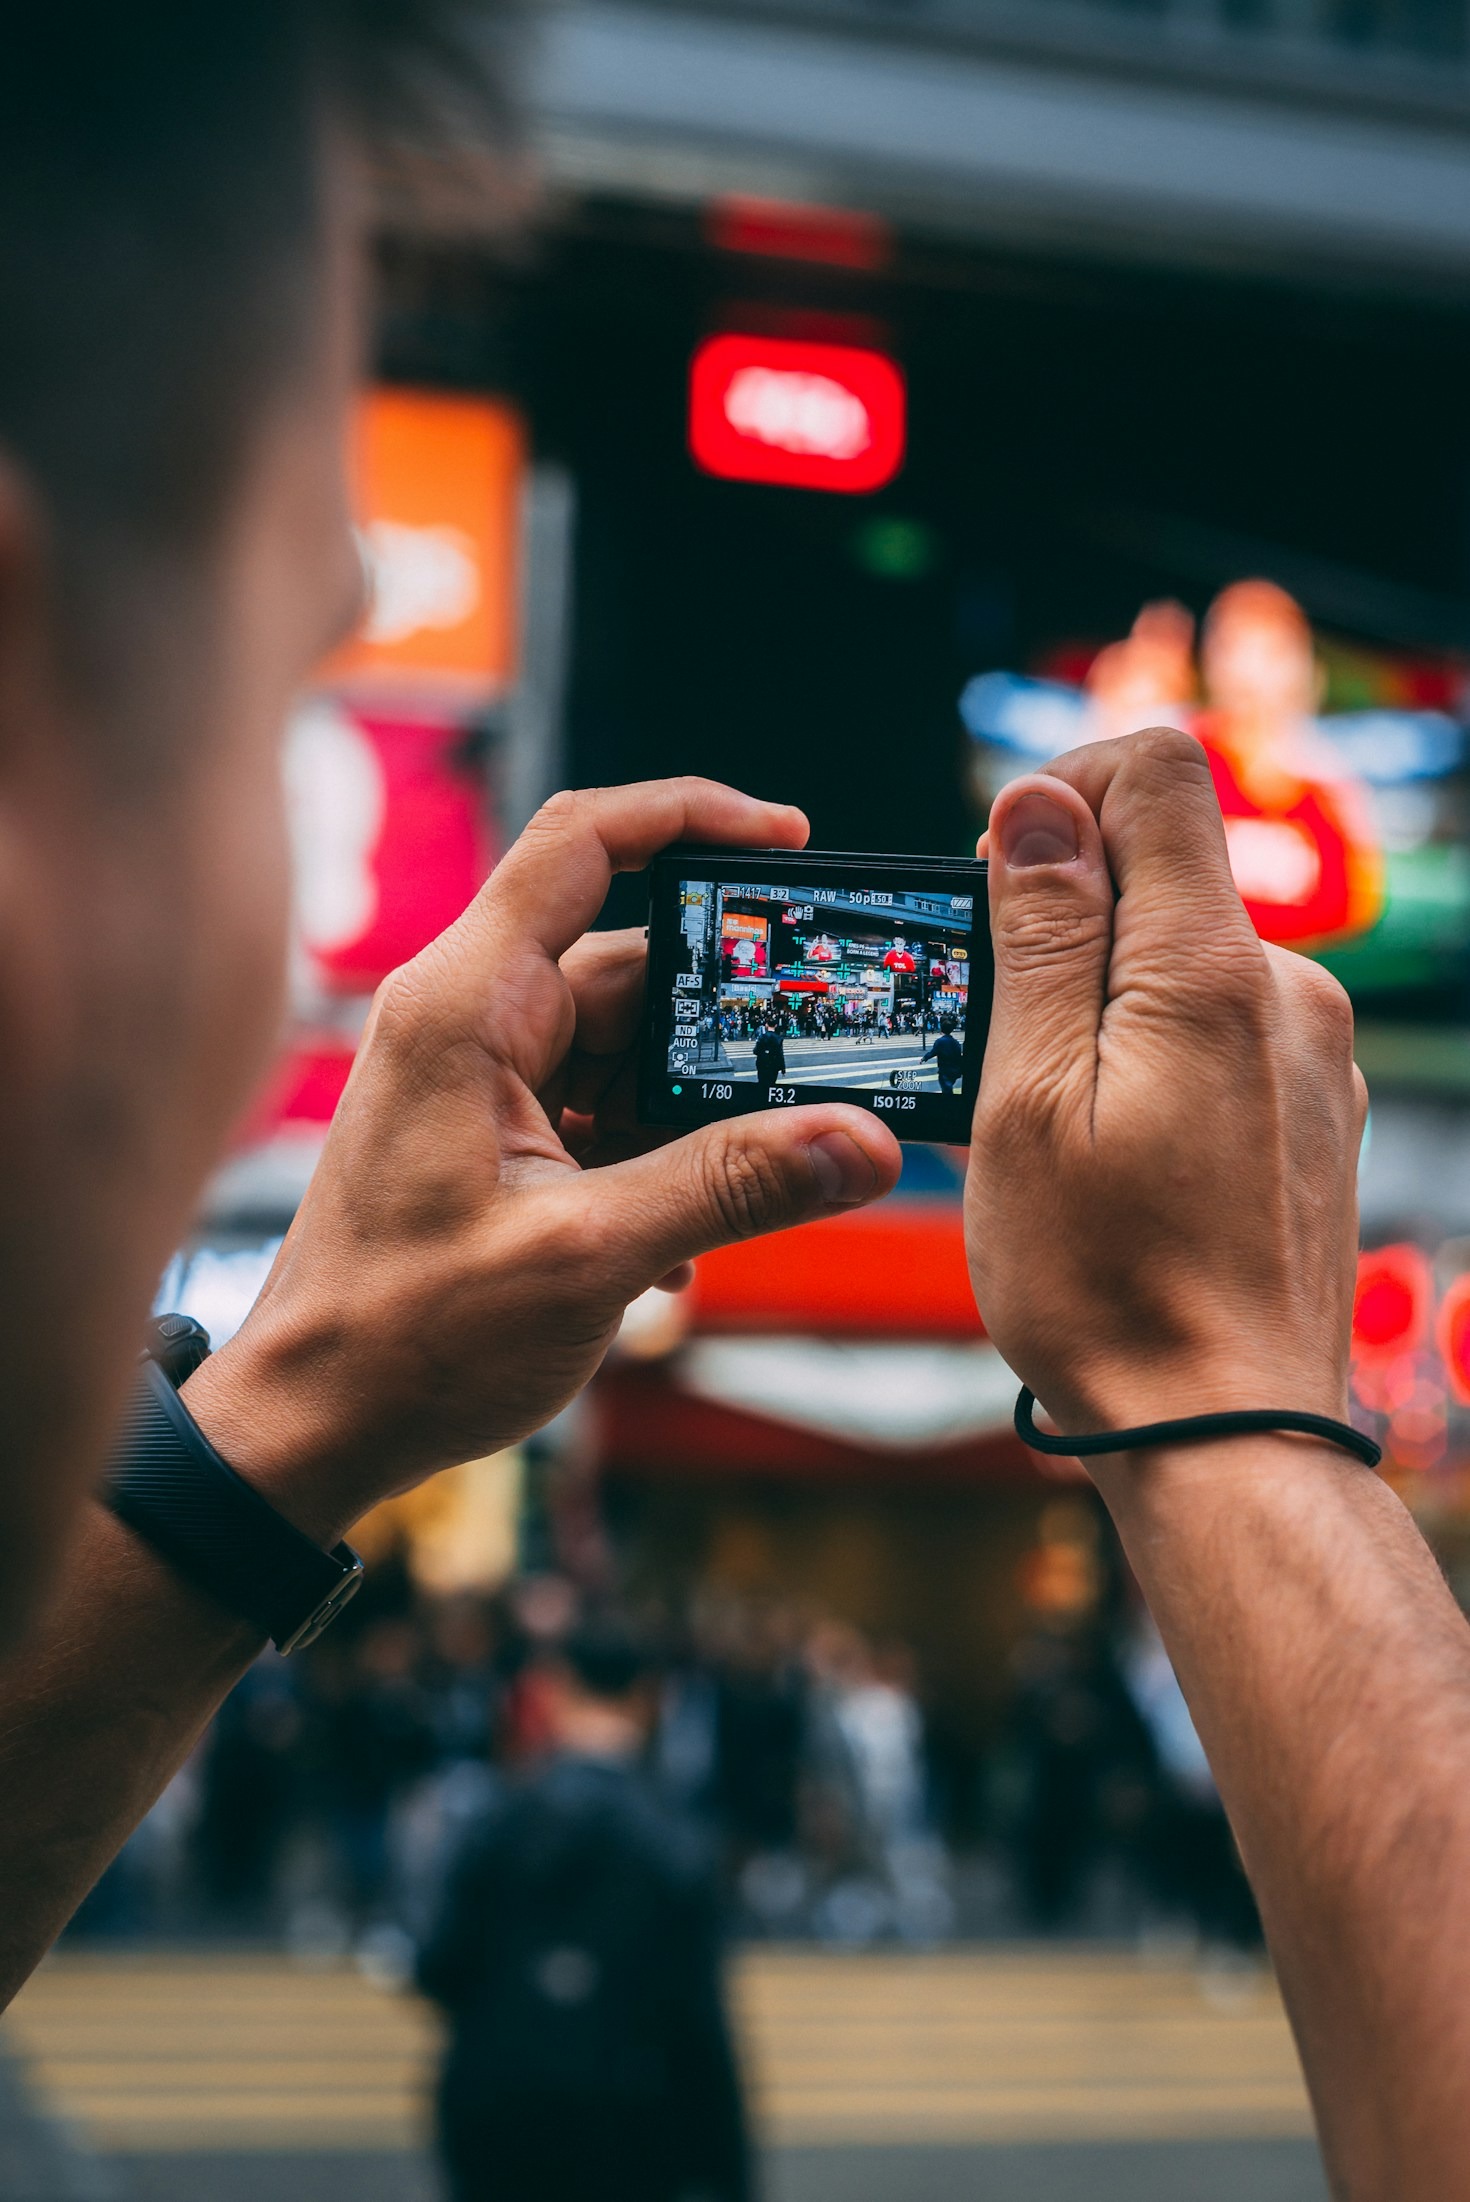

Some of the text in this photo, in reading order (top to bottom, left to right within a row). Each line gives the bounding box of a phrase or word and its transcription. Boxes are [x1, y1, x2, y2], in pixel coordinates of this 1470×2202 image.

[741, 887, 760, 899] 1417
[772, 889, 787, 899] 3:2
[814, 890, 836, 902] RAW
[678, 976, 700, 986] AF-S
[673, 1038, 698, 1048] AUTO
[682, 1065, 696, 1075] ON
[897, 1070, 917, 1080] STEP
[897, 1081, 922, 1090] ZOOM
[702, 1084, 732, 1099] 1/80
[768, 1087, 796, 1103] F3.2
